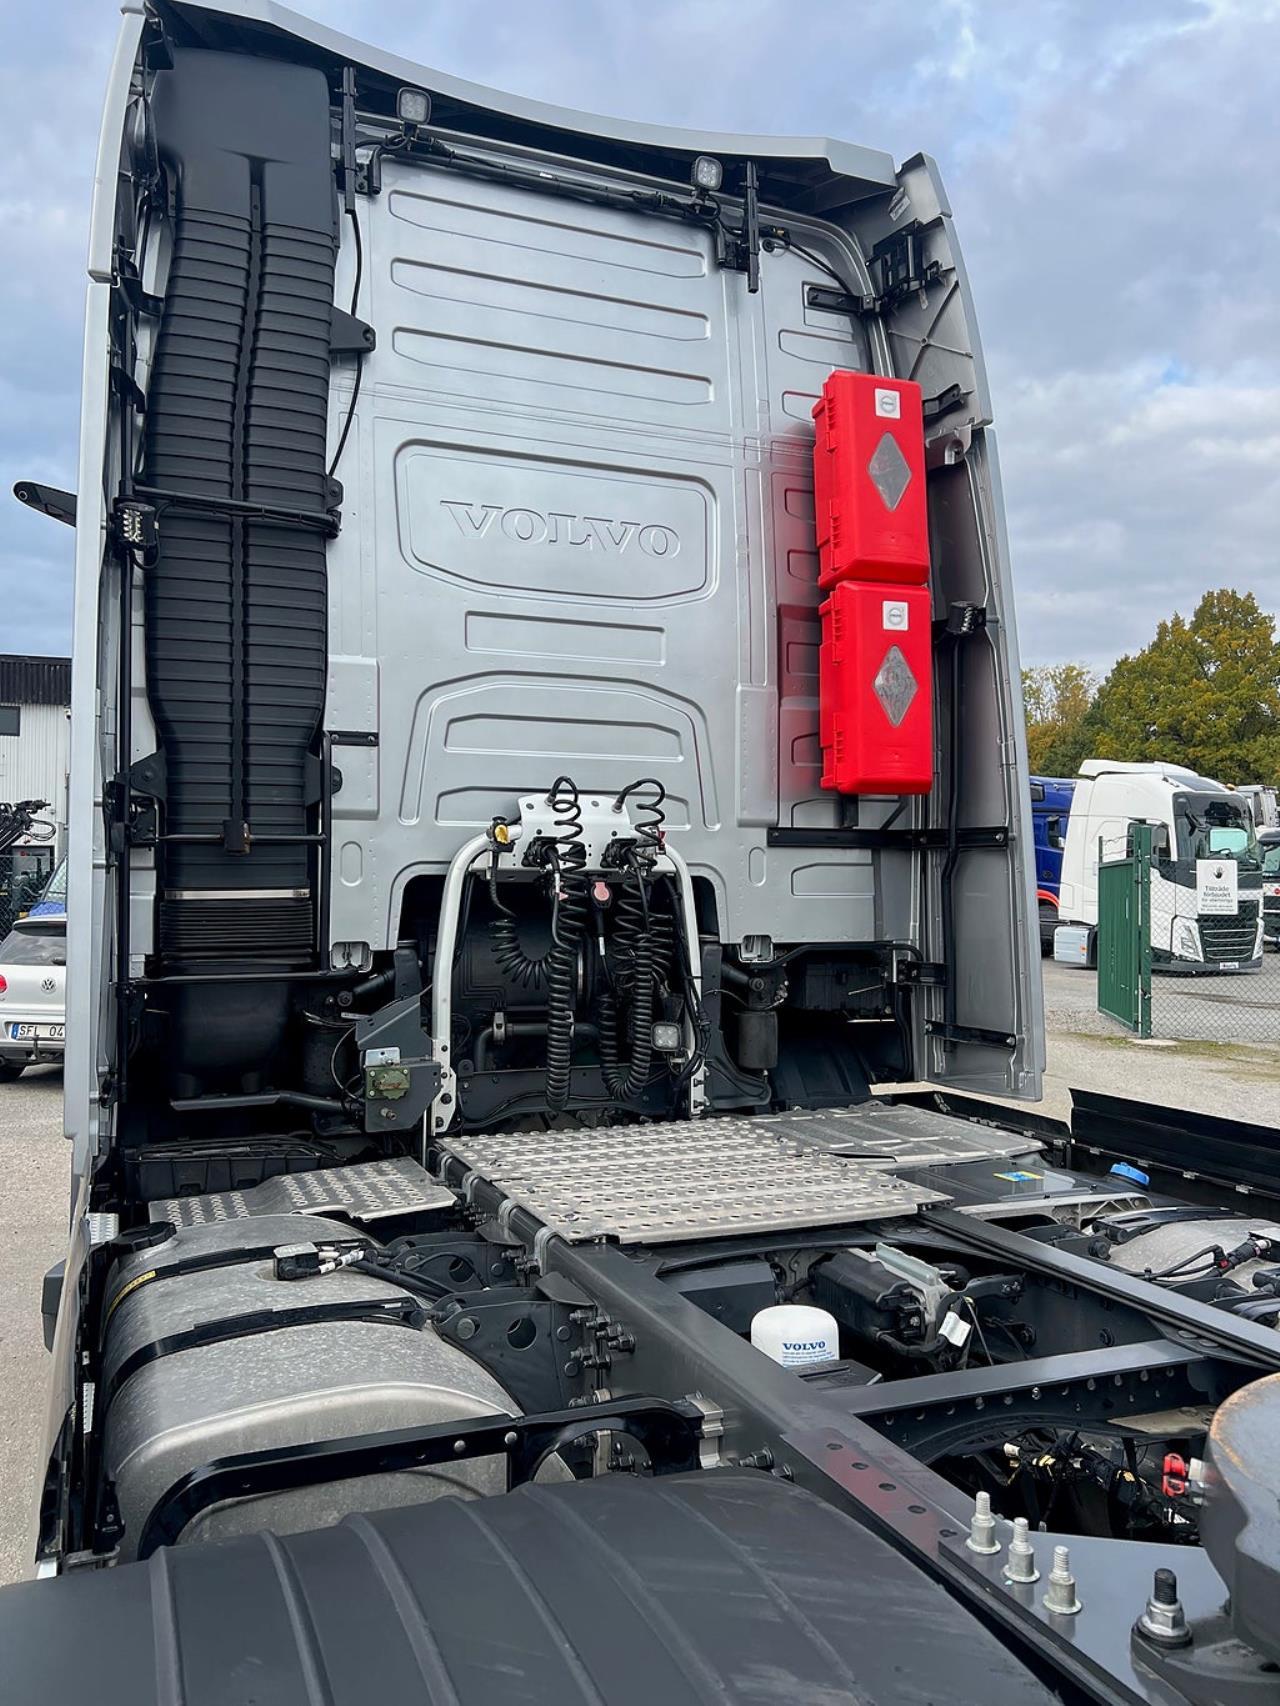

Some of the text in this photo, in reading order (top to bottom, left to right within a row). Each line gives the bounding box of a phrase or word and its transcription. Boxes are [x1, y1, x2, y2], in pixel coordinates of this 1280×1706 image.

[440, 500, 681, 559] VOLVO
[20, 1025, 40, 1037] SFL
[782, 1340, 826, 1351] VOLVO
